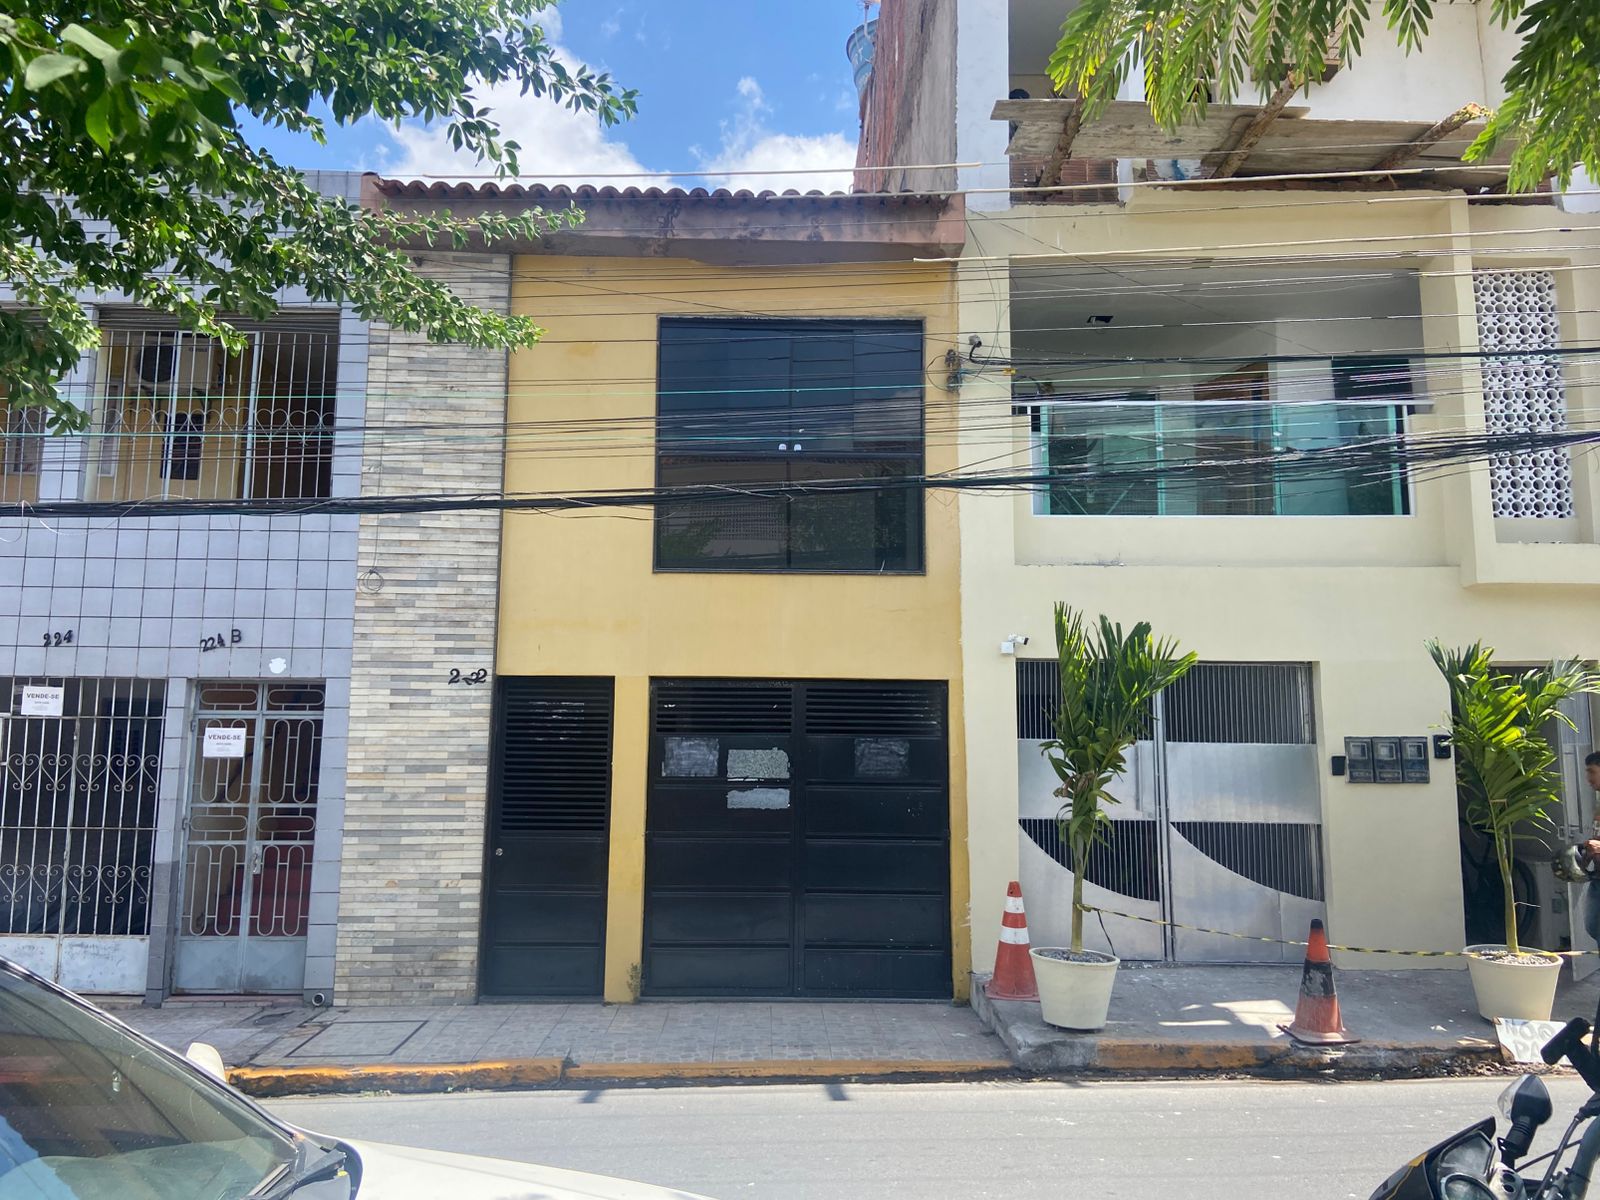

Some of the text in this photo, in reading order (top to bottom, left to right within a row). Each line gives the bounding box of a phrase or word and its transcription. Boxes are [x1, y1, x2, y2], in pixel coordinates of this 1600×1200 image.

[43, 630, 73, 647] 224
[231, 628, 242, 643] B
[26, 692, 60, 700] VENDE-SE
